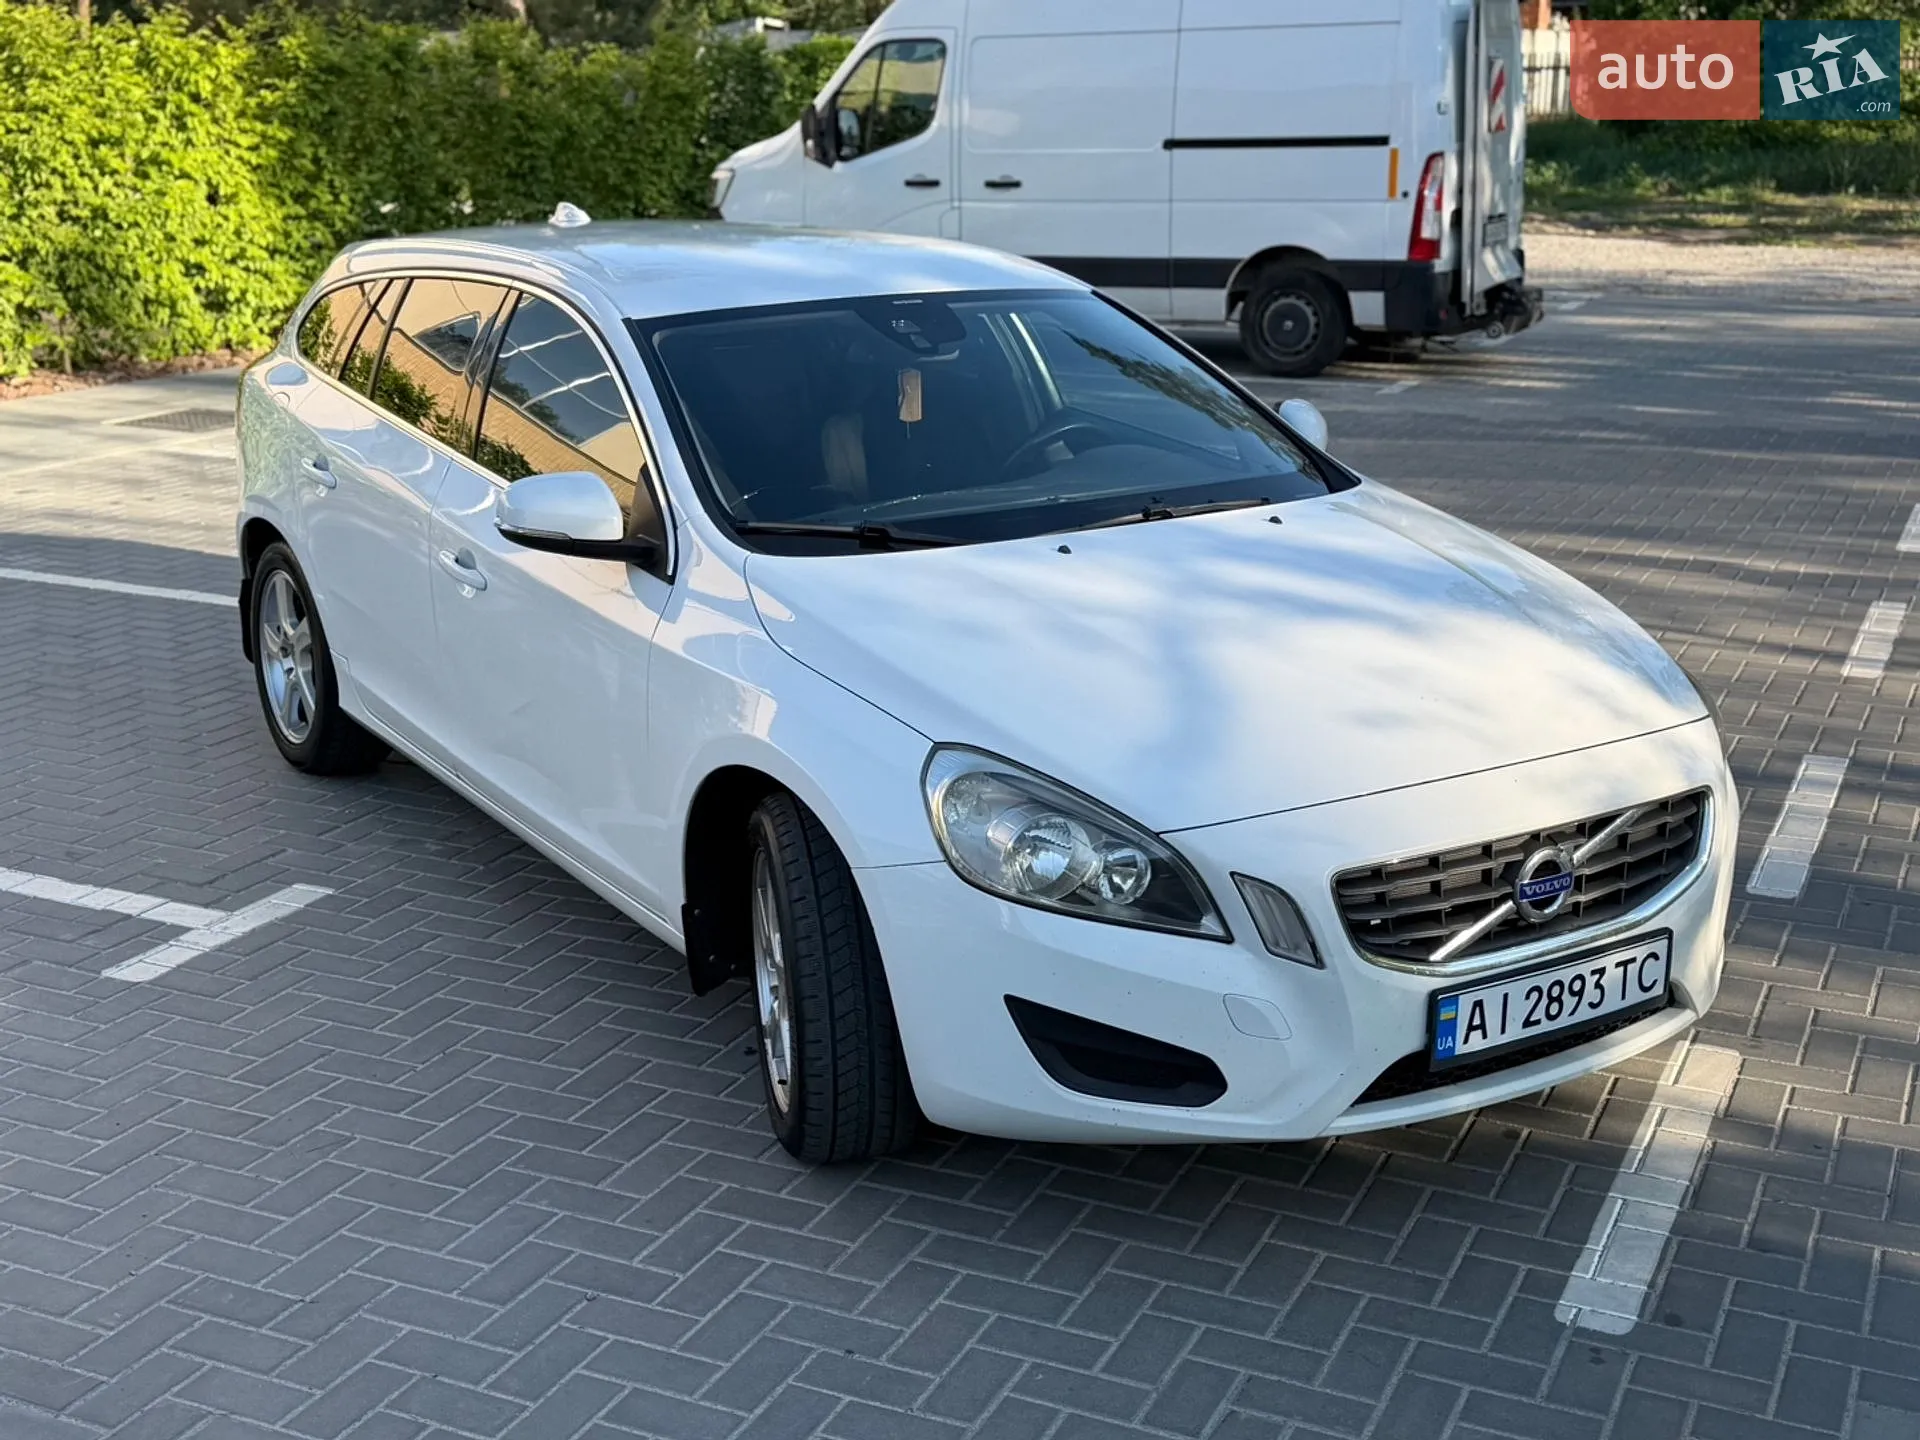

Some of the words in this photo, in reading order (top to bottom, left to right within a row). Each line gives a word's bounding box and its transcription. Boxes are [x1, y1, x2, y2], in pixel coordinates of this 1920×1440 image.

[1522, 876, 1570, 896] VOLVO
[1462, 992, 1509, 1045] AI
[1521, 966, 1607, 1029] 2893
[1614, 951, 1661, 1001] TC
[1437, 1035, 1454, 1050] UA
